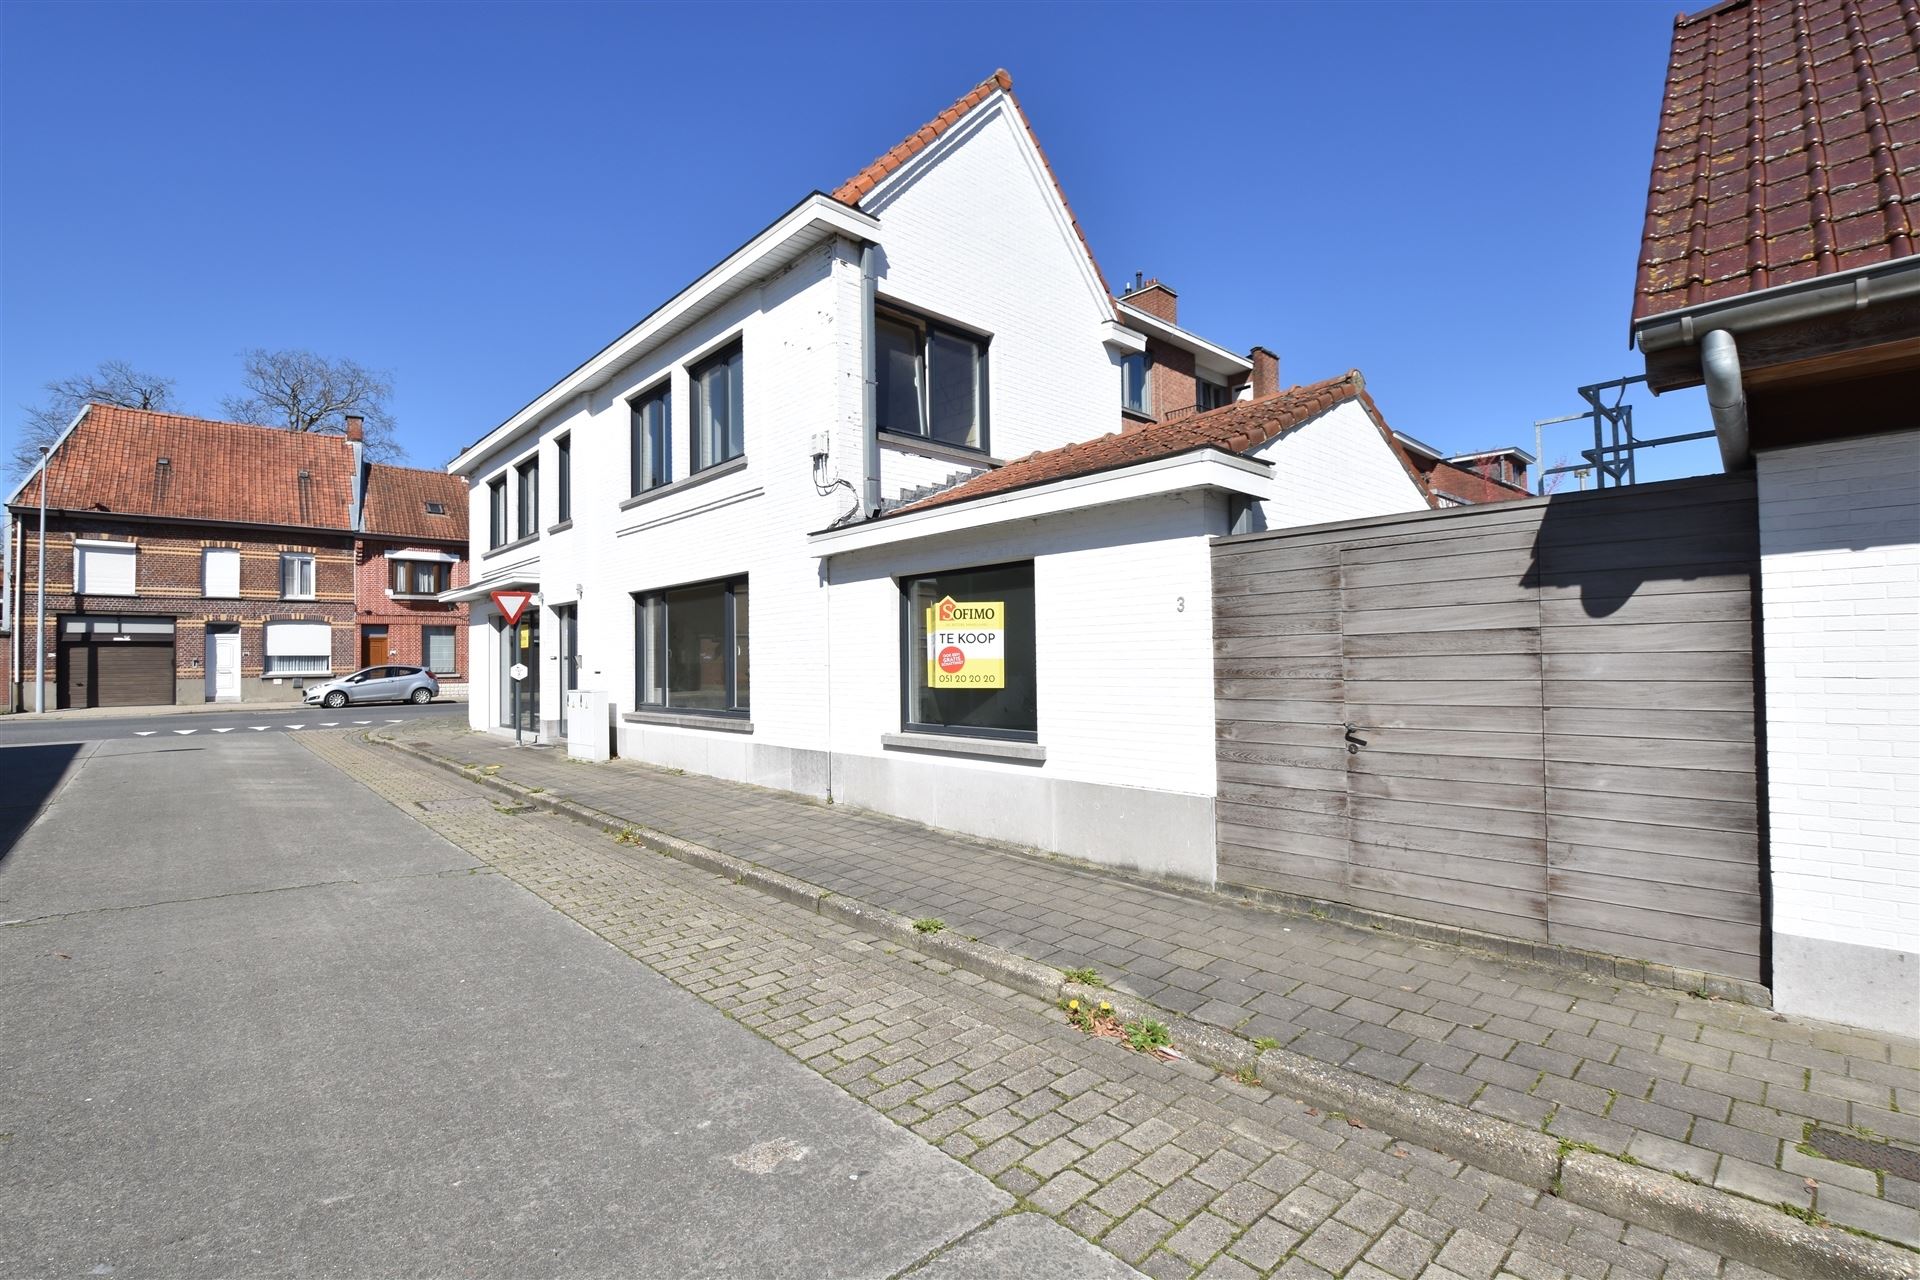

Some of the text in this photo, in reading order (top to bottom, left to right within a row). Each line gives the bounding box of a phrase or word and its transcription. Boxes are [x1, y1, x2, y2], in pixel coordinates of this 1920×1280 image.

[942, 603, 995, 620] SOFIMO
[1176, 596, 1185, 613] 3
[939, 633, 995, 644] TE KOOP
[939, 674, 996, 683] 051 20 20 20
